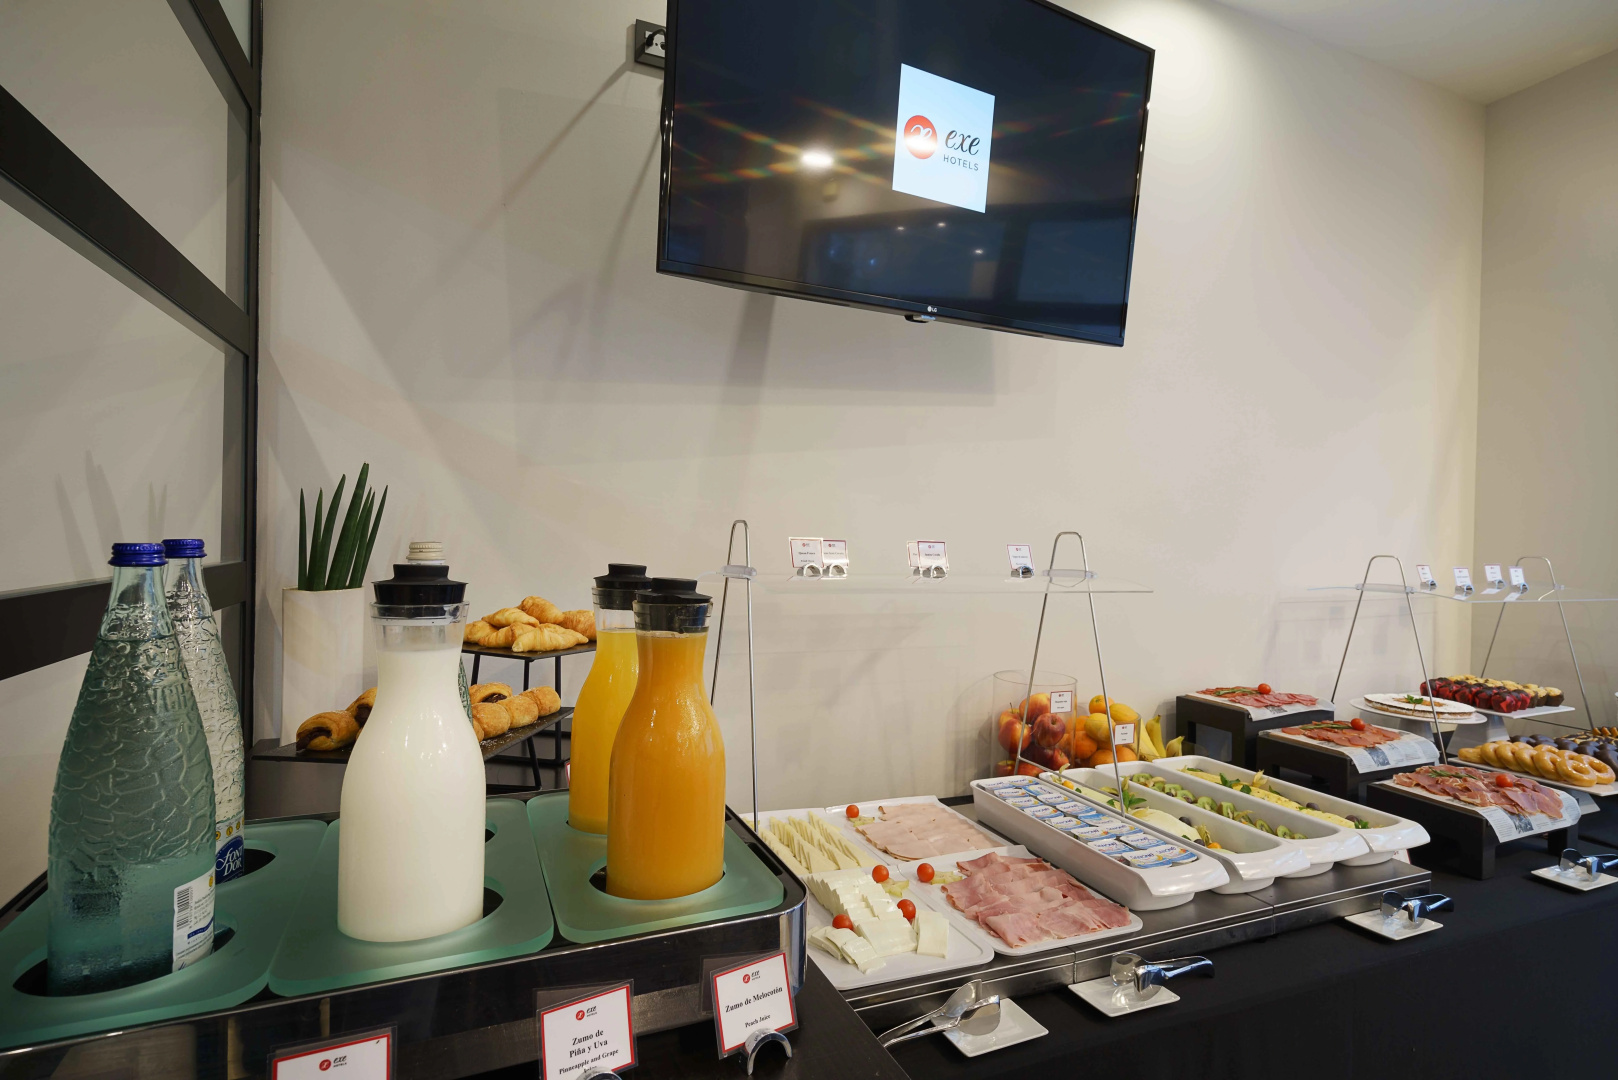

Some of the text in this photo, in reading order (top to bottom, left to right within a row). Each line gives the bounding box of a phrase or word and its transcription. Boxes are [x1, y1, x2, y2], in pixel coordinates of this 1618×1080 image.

[945, 129, 980, 155] exe
[943, 154, 979, 171] HOTELS
[725, 1001, 744, 1013] Zumo
[744, 997, 752, 1006] de
[744, 1014, 771, 1028] Peach Juice
[572, 1029, 604, 1046] Zumo de
[569, 1040, 608, 1059] Piña y Uva
[590, 1054, 601, 1063] and
[601, 1049, 619, 1059] Grape
